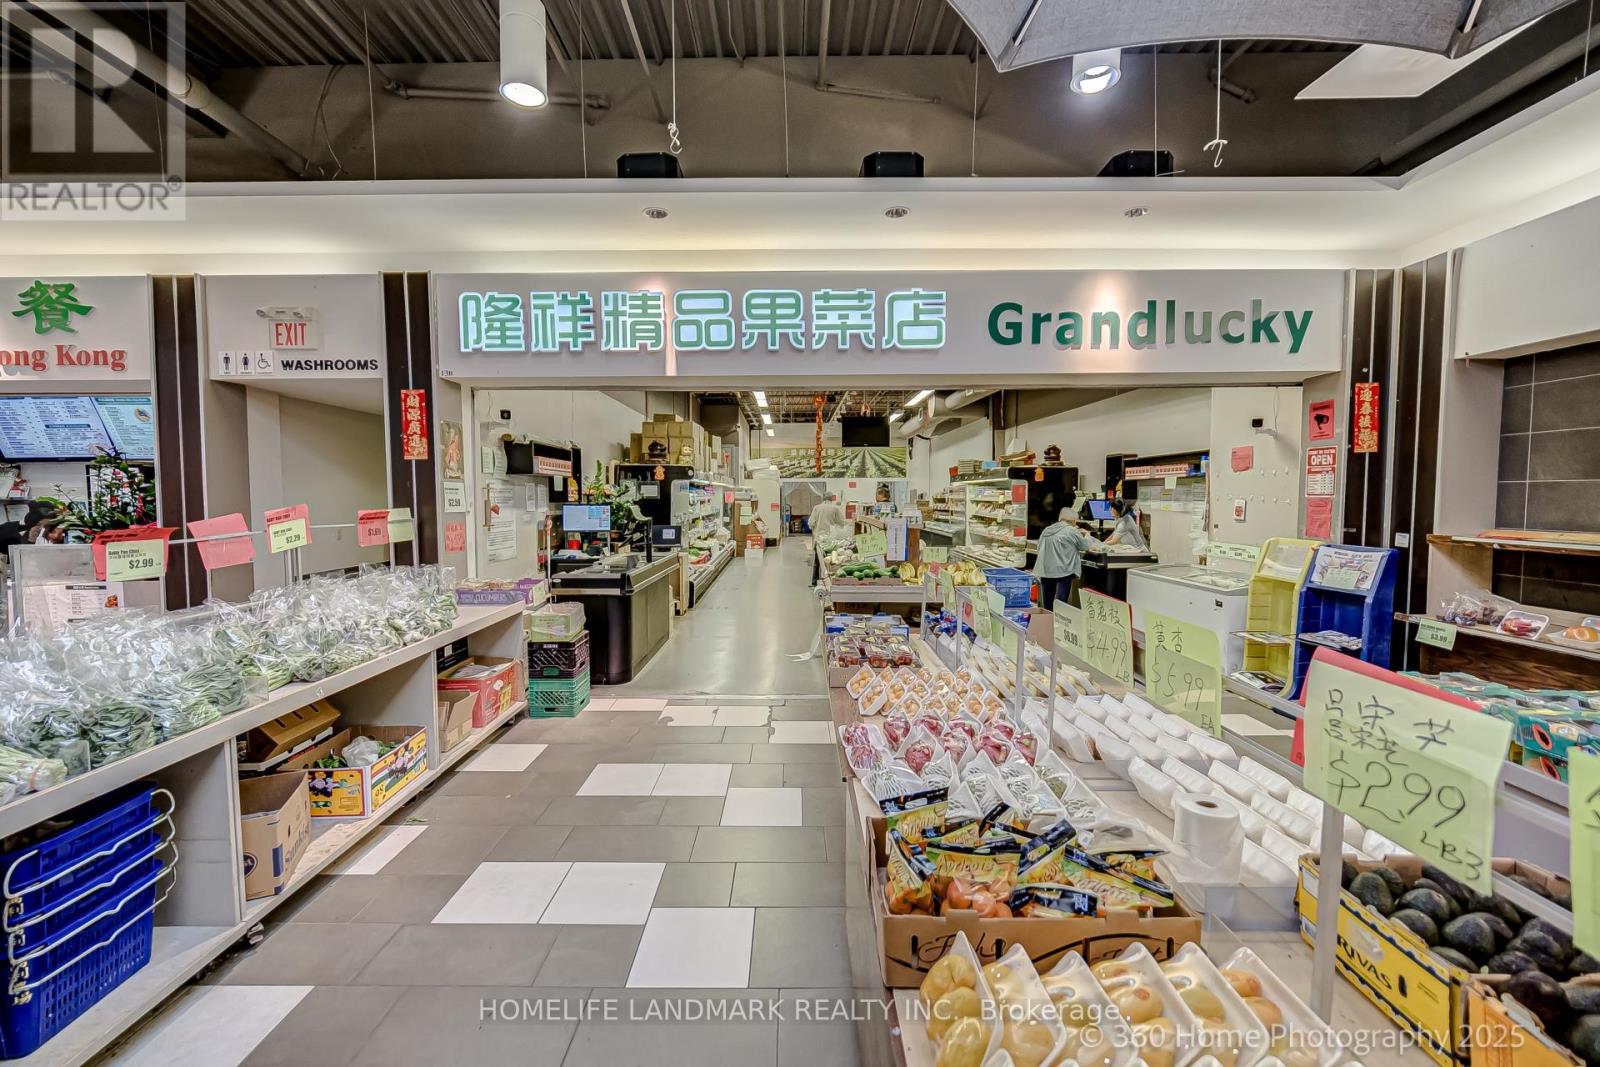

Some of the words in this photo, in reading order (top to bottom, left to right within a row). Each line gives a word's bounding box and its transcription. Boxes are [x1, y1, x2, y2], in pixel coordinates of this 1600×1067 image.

[11, 280, 94, 335] 餐
[458, 288, 948, 352] 隆祥精品果菜店
[275, 322, 307, 346] EXIT
[988, 299, 1313, 353] Grandlucky
[55, 344, 127, 371] Kong
[281, 359, 378, 371] WASHROOMS
[1310, 454, 1334, 466] OPEN
[128, 558, 154, 569] $2.99
